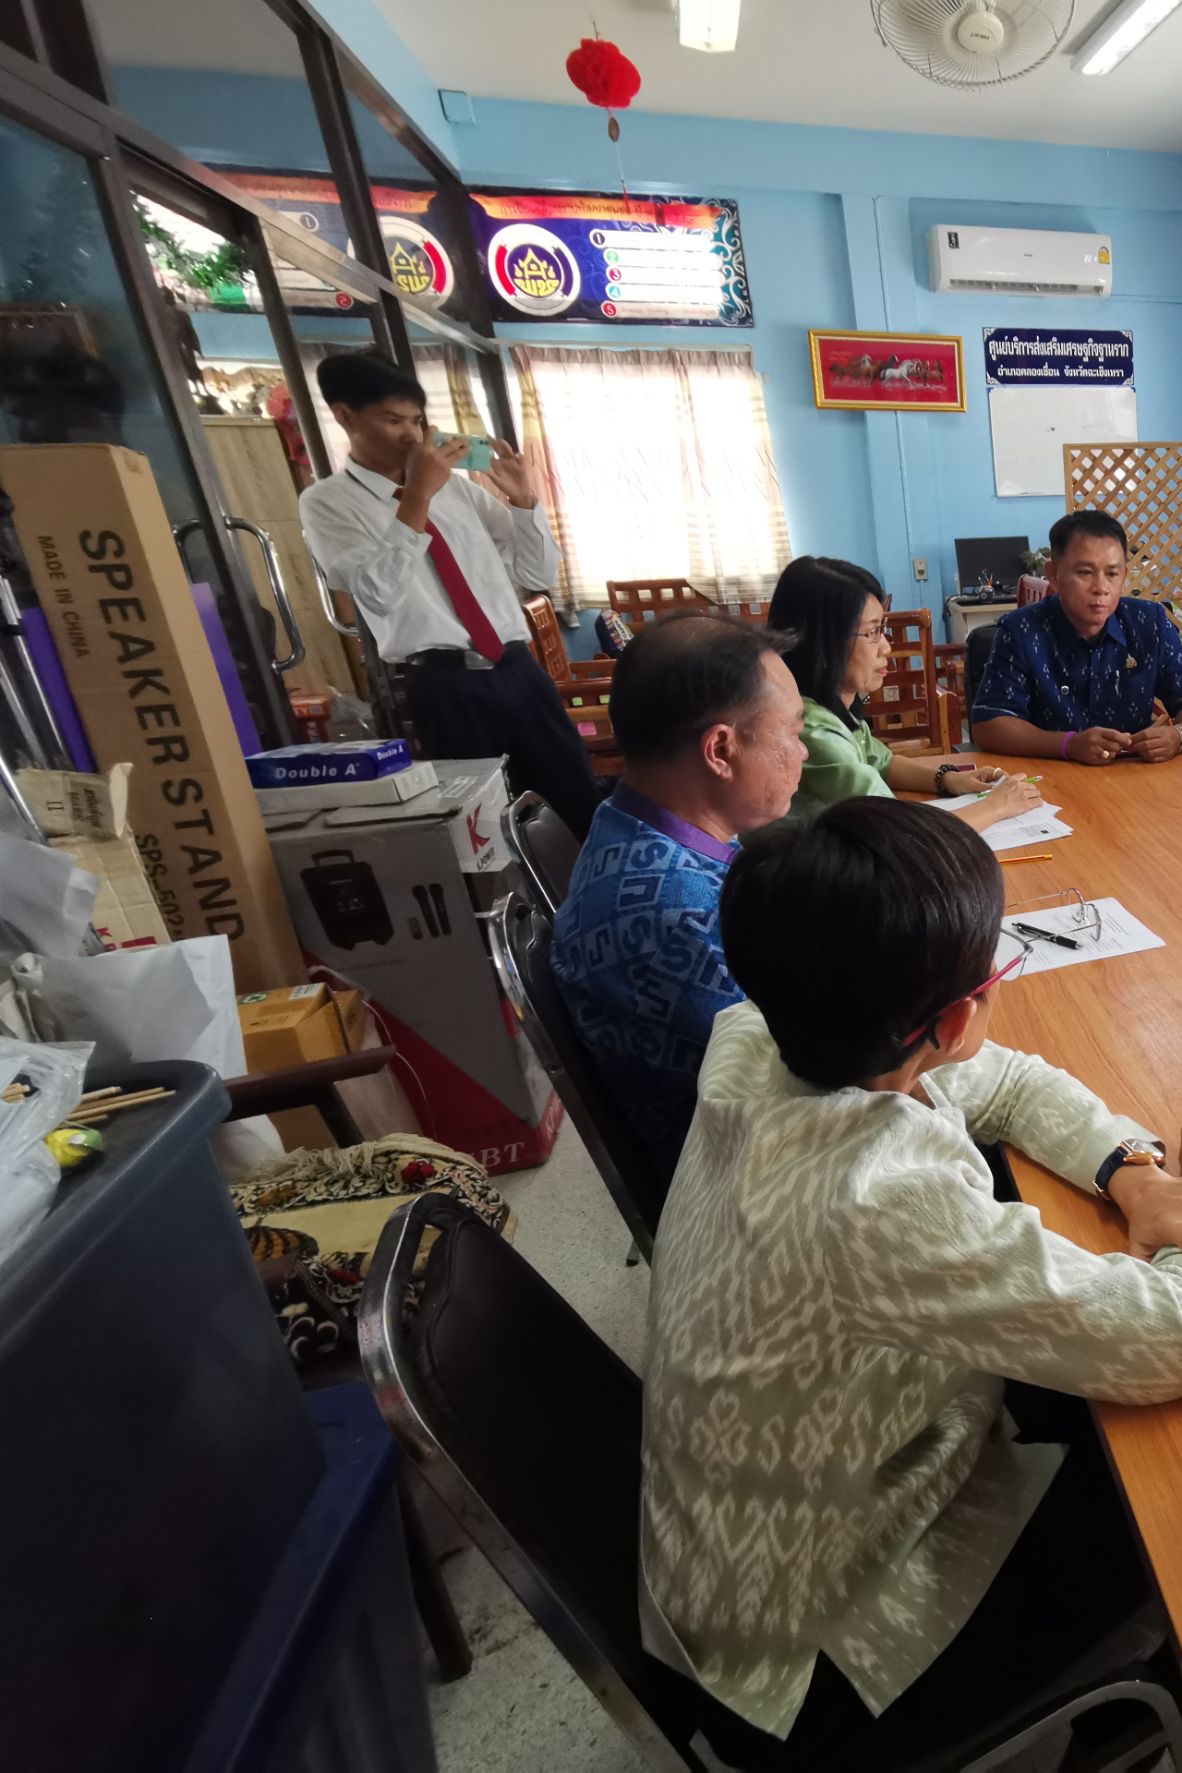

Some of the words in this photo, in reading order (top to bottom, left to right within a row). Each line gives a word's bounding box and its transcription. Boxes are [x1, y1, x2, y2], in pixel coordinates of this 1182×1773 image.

[988, 335, 1129, 363] ศูนย์บริการส่งเสริมเศรษฐกิจฐานราก
[997, 363, 1060, 378] อำเภอคลองเขื่อน
[1064, 365, 1124, 379] จังหวัดฉะเชิงเทรา
[37, 534, 66, 582] MADE
[54, 588, 73, 604] IN
[62, 611, 91, 660] CHINA
[79, 529, 191, 767] SPEAKER
[162, 777, 245, 942] STAND
[376, 748, 398, 761] Double
[274, 764, 337, 780] Double
[345, 763, 358, 776] A
[477, 1141, 525, 1168] BT
